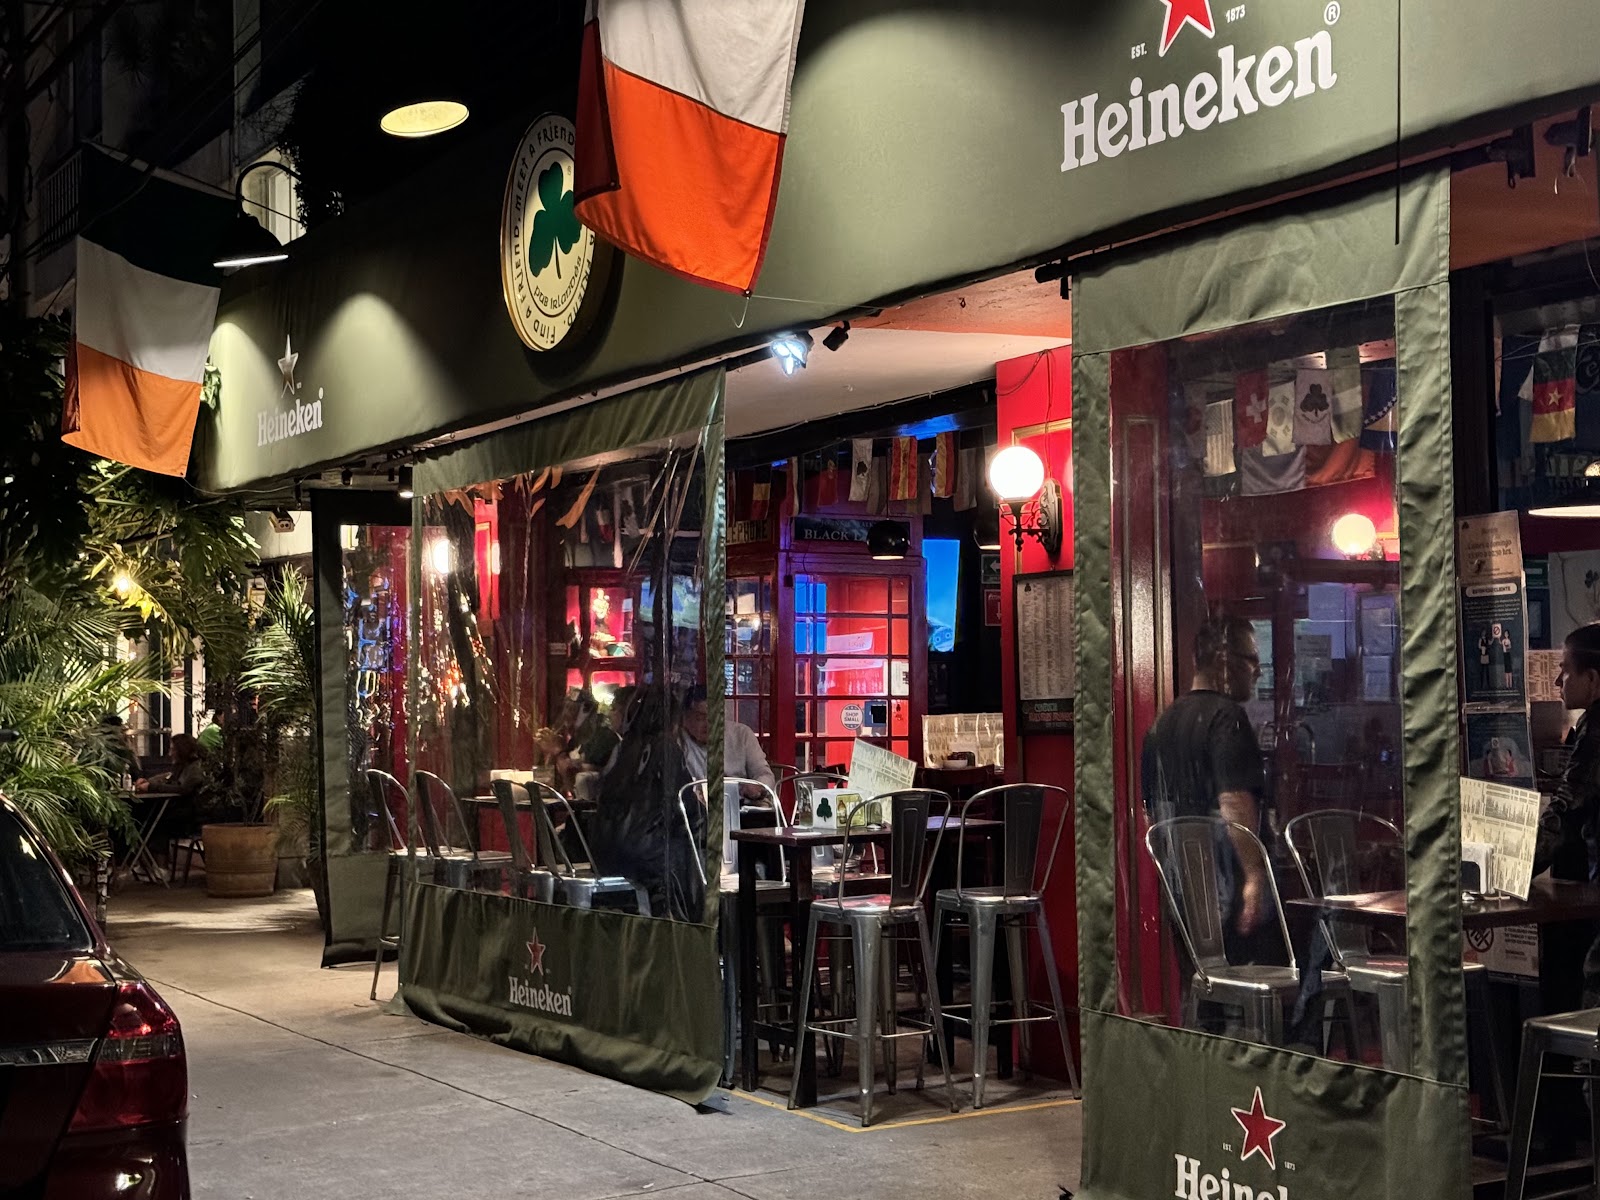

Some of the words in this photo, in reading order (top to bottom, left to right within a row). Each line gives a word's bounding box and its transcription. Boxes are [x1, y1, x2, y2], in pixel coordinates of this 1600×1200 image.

[1225, 4, 1246, 24] 1873
[1130, 42, 1148, 60] EST.
[1060, 30, 1338, 173] Heineken
[514, 157, 529, 212] MEET
[528, 143, 536, 157] A
[525, 305, 533, 319] A
[257, 398, 324, 447] Heineken
[803, 528, 849, 541] BLACK
[508, 975, 573, 1017] Heineken
